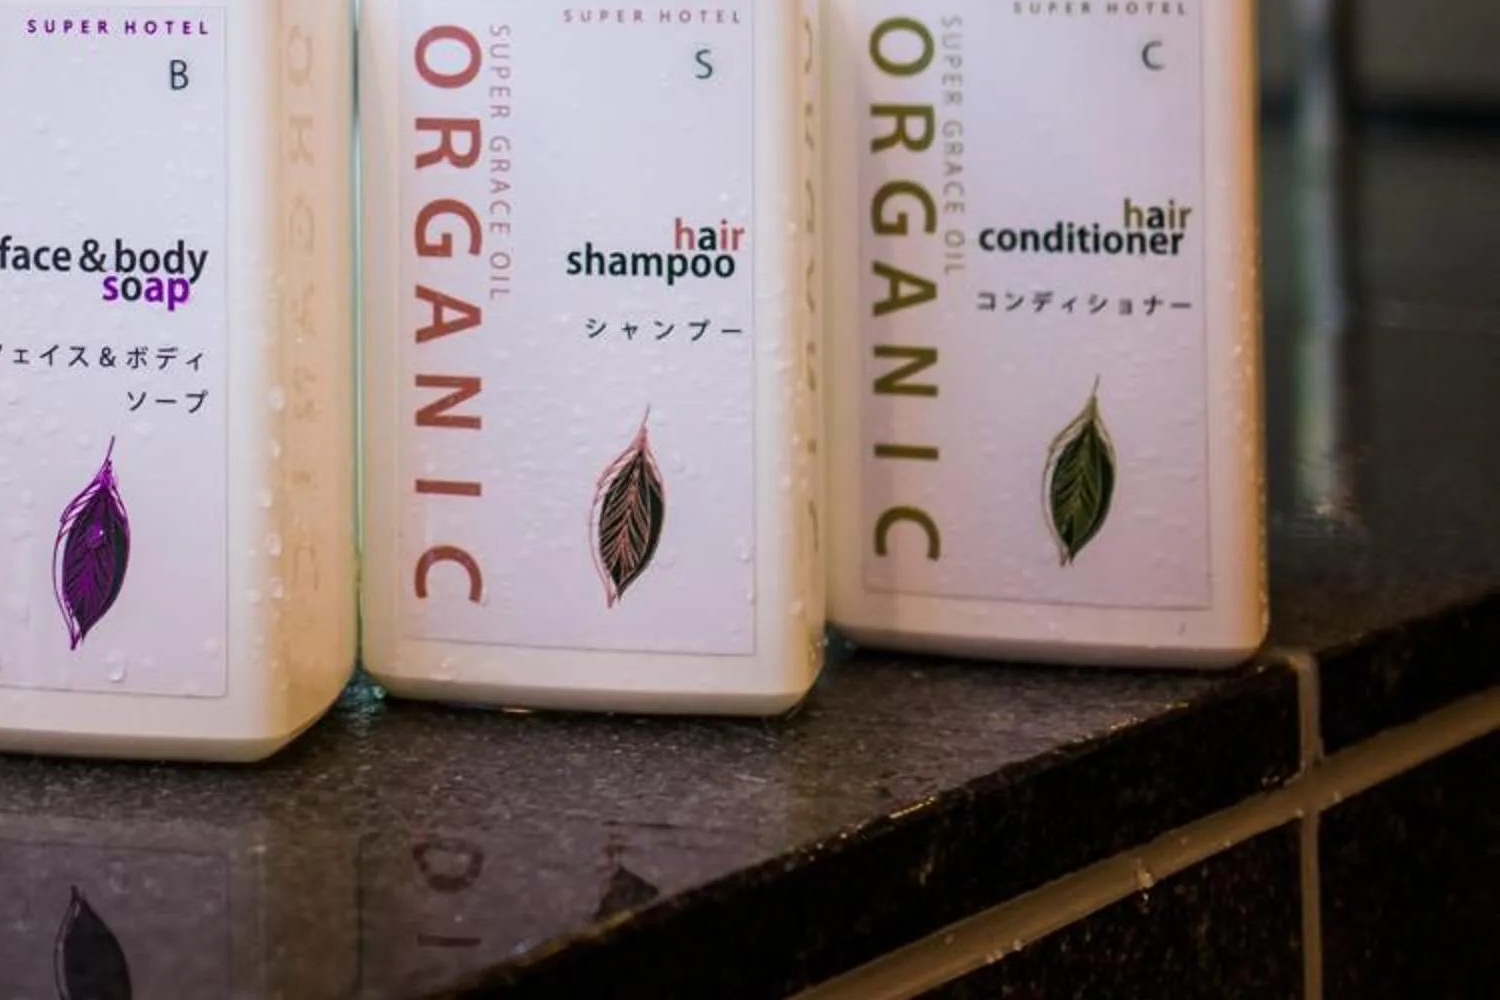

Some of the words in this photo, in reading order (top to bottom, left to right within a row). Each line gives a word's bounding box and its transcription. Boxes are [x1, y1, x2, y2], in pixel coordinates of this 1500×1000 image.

[26, 18, 109, 35] SUPER
[124, 20, 209, 35] HOTEL
[563, 8, 644, 24] SUPER
[659, 8, 741, 24] HOTEL
[1012, 0, 1092, 15] SUPER
[1106, 0, 1188, 16] HOTEL
[489, 23, 512, 119] SUPER
[694, 48, 714, 80] S
[941, 14, 964, 107] SUPER
[1141, 39, 1165, 71] C
[169, 58, 190, 91] B
[489, 135, 512, 235] GRACE
[942, 119, 965, 214] GRACE
[1123, 196, 1192, 230] hair
[674, 216, 745, 251] hair
[943, 228, 966, 276] OIL
[978, 220, 1184, 256] conditioner
[114, 237, 209, 285] body
[489, 250, 512, 301] OIL
[565, 241, 736, 287] shampoo
[102, 274, 191, 312] soap
[868, 16, 942, 562] ORGANIC
[414, 24, 484, 604] ORGANIC
[585, 317, 743, 342] シャンプー
[126, 389, 209, 415] ソープ
